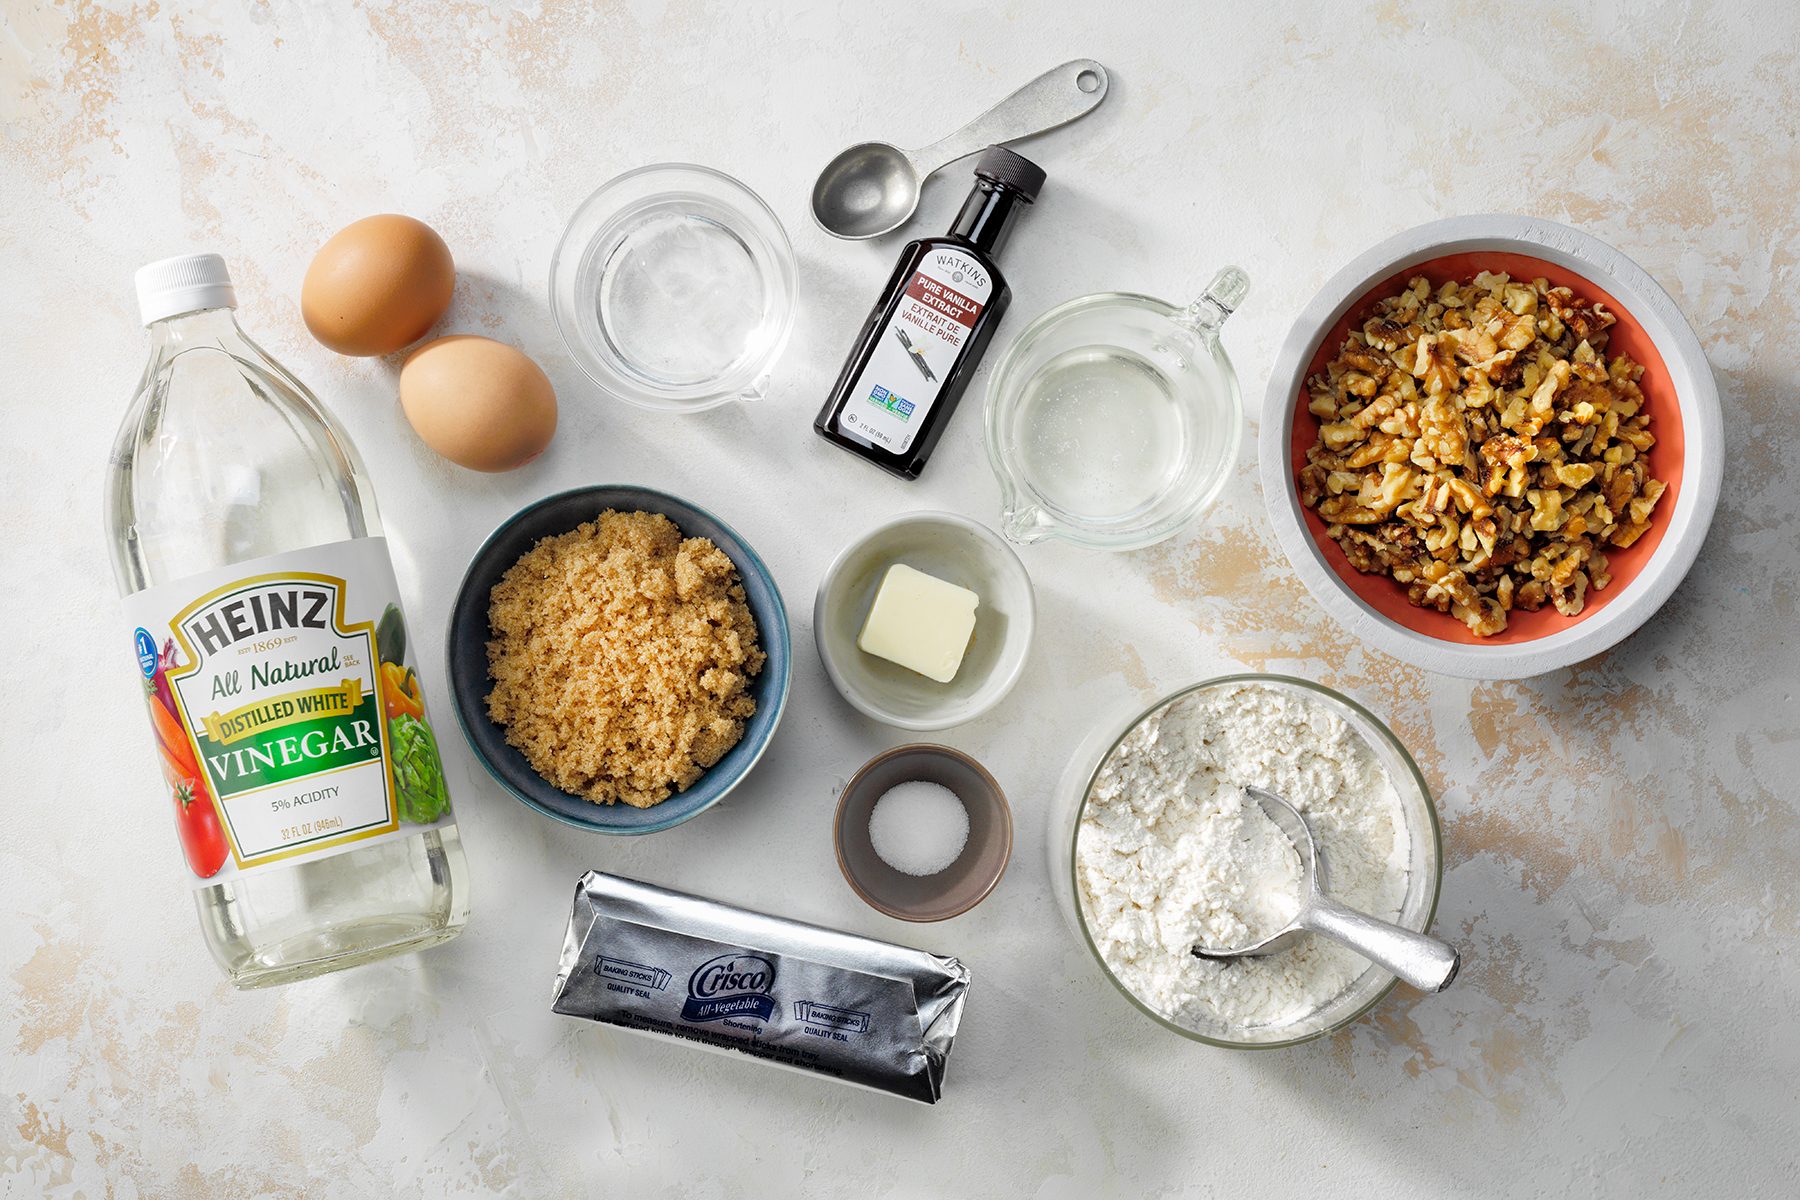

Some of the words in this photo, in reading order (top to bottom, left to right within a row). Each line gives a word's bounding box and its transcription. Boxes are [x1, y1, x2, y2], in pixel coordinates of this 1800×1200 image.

[936, 255, 986, 287] WATKINS
[917, 277, 942, 296] PURE
[942, 290, 977, 314] VANILLA
[922, 292, 963, 319] EXTRACT
[901, 310, 936, 334] VANILLE
[936, 328, 960, 347] PURE
[911, 303, 947, 327] EXTRAIT
[947, 322, 960, 335] DE
[190, 591, 329, 657] HEINZ
[253, 637, 282, 654] 1869
[211, 669, 242, 701] All
[250, 646, 342, 690] Natural
[344, 660, 360, 668] BACK
[219, 700, 294, 739] DISTILLED
[296, 692, 348, 714] WHITE
[208, 720, 378, 782] VINEGAR
[271, 799, 291, 813] 5%
[293, 786, 341, 807] ACIDITY
[281, 828, 291, 841] 32
[291, 827, 302, 838] FL
[303, 824, 313, 836] OZ
[313, 816, 344, 834] (946mL)
[603, 965, 629, 977] BAKING
[629, 970, 653, 982] STICKS
[696, 961, 766, 998] Crisco
[607, 982, 634, 996] QUALITY
[634, 988, 651, 1000] SEAL
[698, 997, 760, 1017] All-Vegetable
[811, 1010, 836, 1022] BAKING
[836, 1015, 860, 1027] STICKS
[621, 1009, 633, 1019] To
[676, 1024, 710, 1037] remove
[711, 1031, 749, 1047] wrapped
[778, 1044, 800, 1056] from
[685, 1034, 700, 1043] cut
[722, 1018, 763, 1035] Shortening
[804, 1026, 831, 1039] QUALITY
[832, 1032, 849, 1042] SEAL
